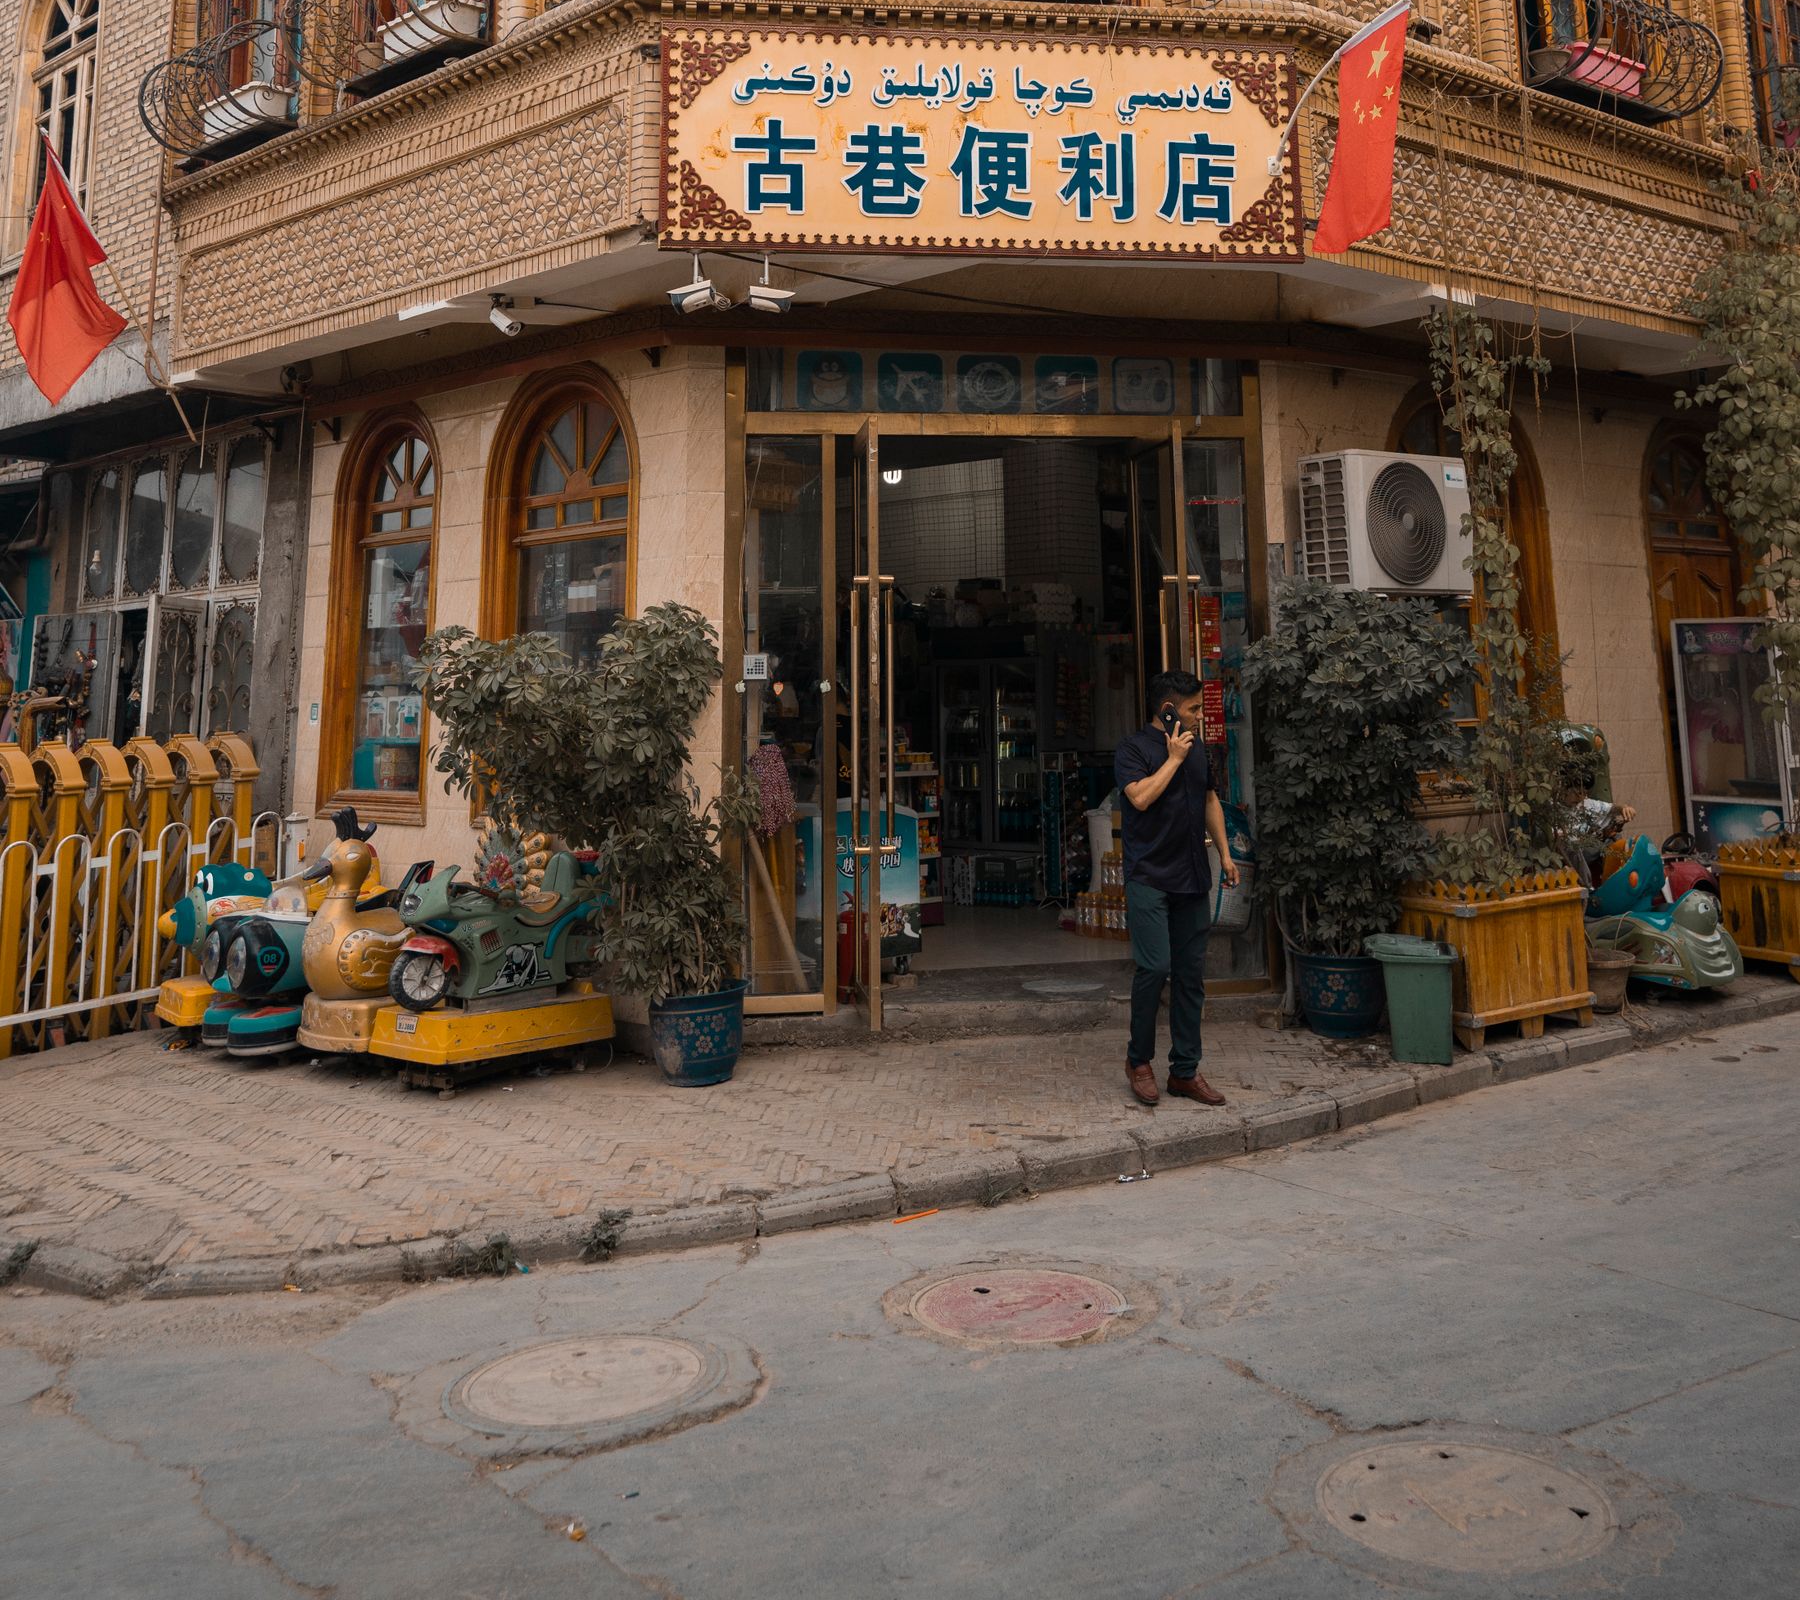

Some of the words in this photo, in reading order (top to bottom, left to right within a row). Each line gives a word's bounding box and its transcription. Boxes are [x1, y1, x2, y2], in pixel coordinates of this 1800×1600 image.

[733, 61, 853, 104] دۇكىنى
[872, 62, 997, 109] قولايلىق
[1013, 66, 1095, 116] كوچا
[732, 118, 1237, 226] 古巷便利店
[263, 953, 277, 964] 08
